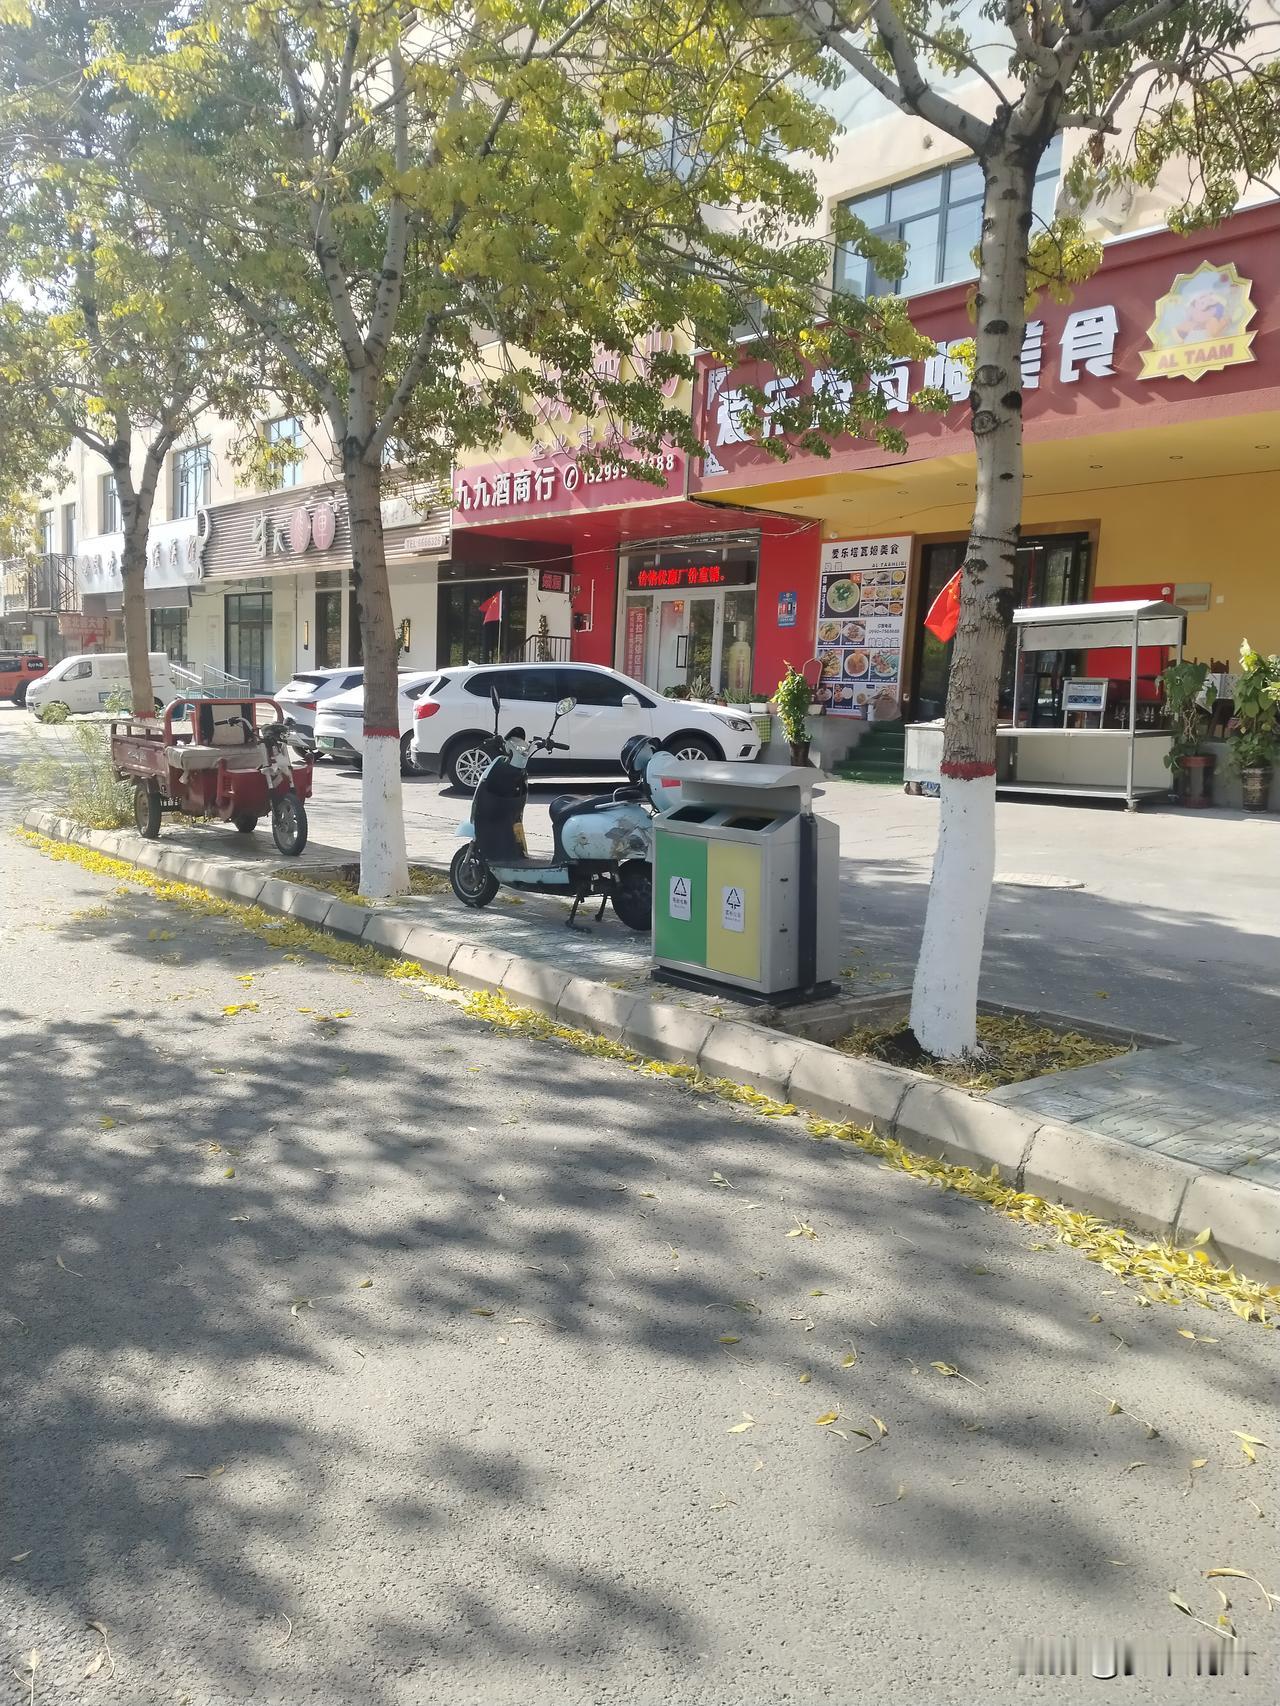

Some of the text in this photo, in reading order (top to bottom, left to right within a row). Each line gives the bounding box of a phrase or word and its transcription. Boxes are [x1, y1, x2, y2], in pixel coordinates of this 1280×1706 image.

[1158, 342, 1234, 371] AL TAAM
[455, 465, 556, 511] 九九酒商行
